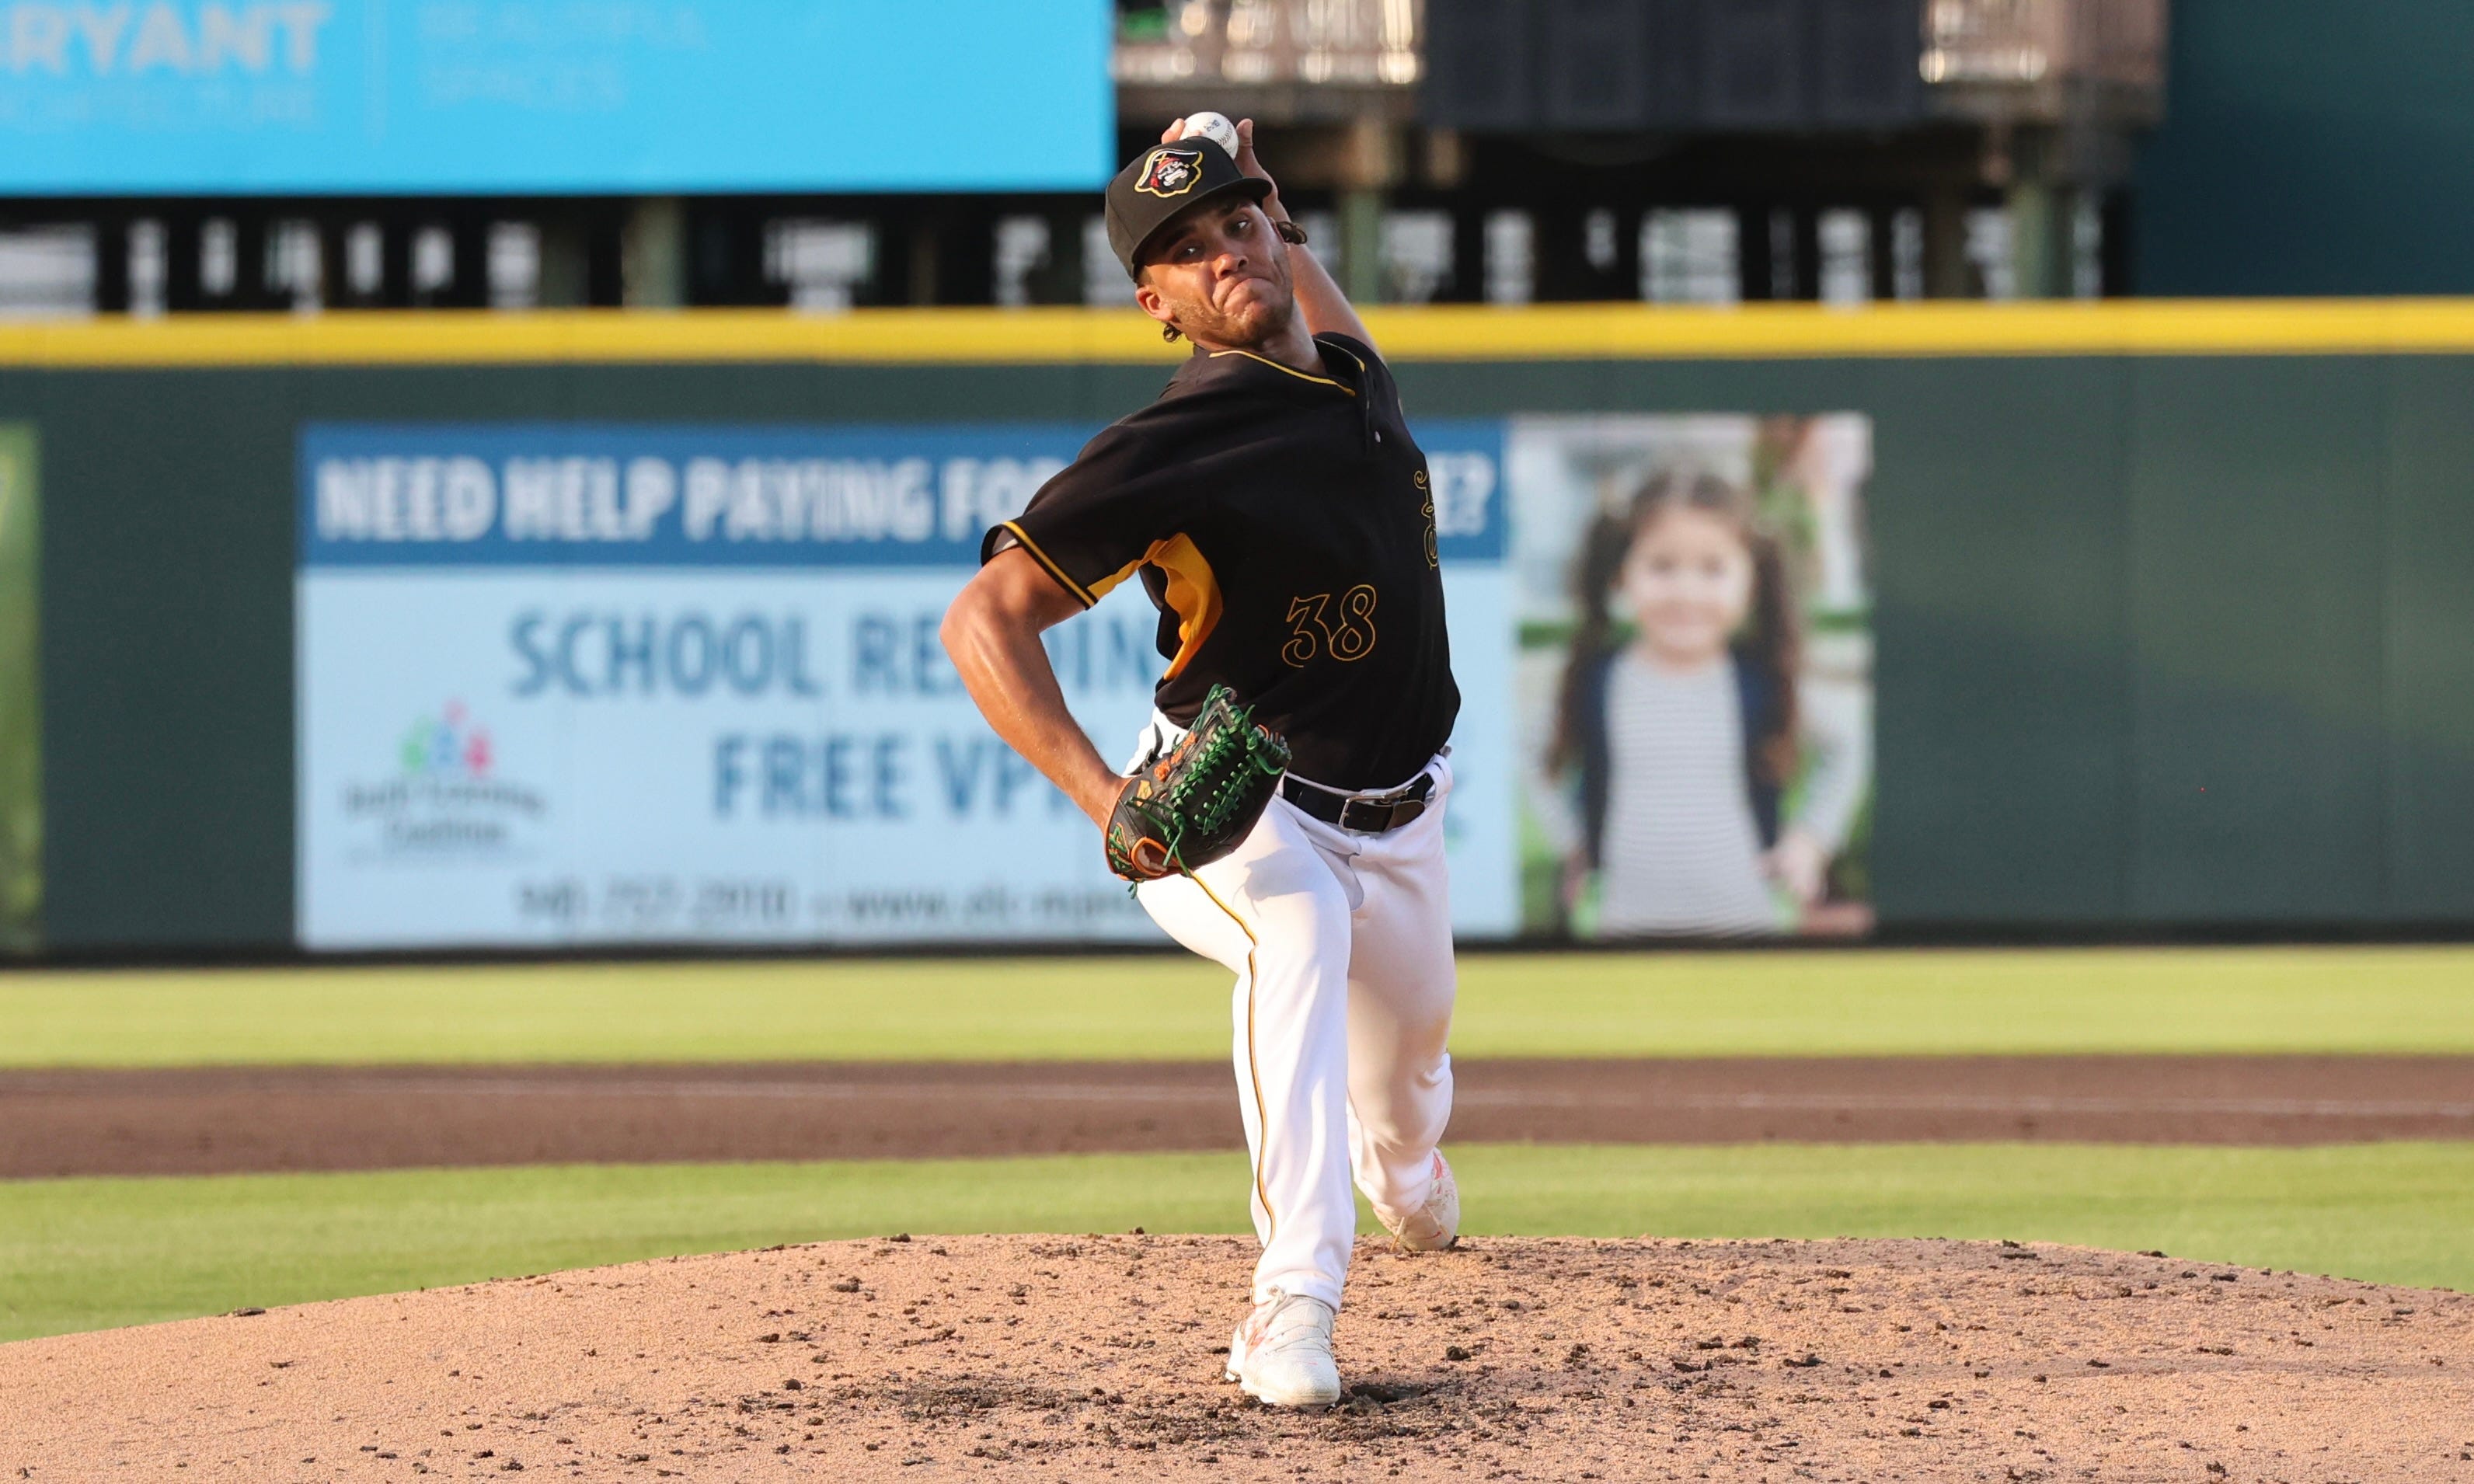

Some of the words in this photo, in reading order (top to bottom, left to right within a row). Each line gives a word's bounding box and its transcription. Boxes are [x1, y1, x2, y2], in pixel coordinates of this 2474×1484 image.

[0, 2, 333, 75] RYANT
[317, 455, 499, 542] NEED
[502, 455, 678, 542] HELP
[682, 455, 932, 542] PAYING
[505, 608, 817, 699] SCHOOL
[1282, 583, 1377, 668] 38
[711, 731, 917, 820] FREE
